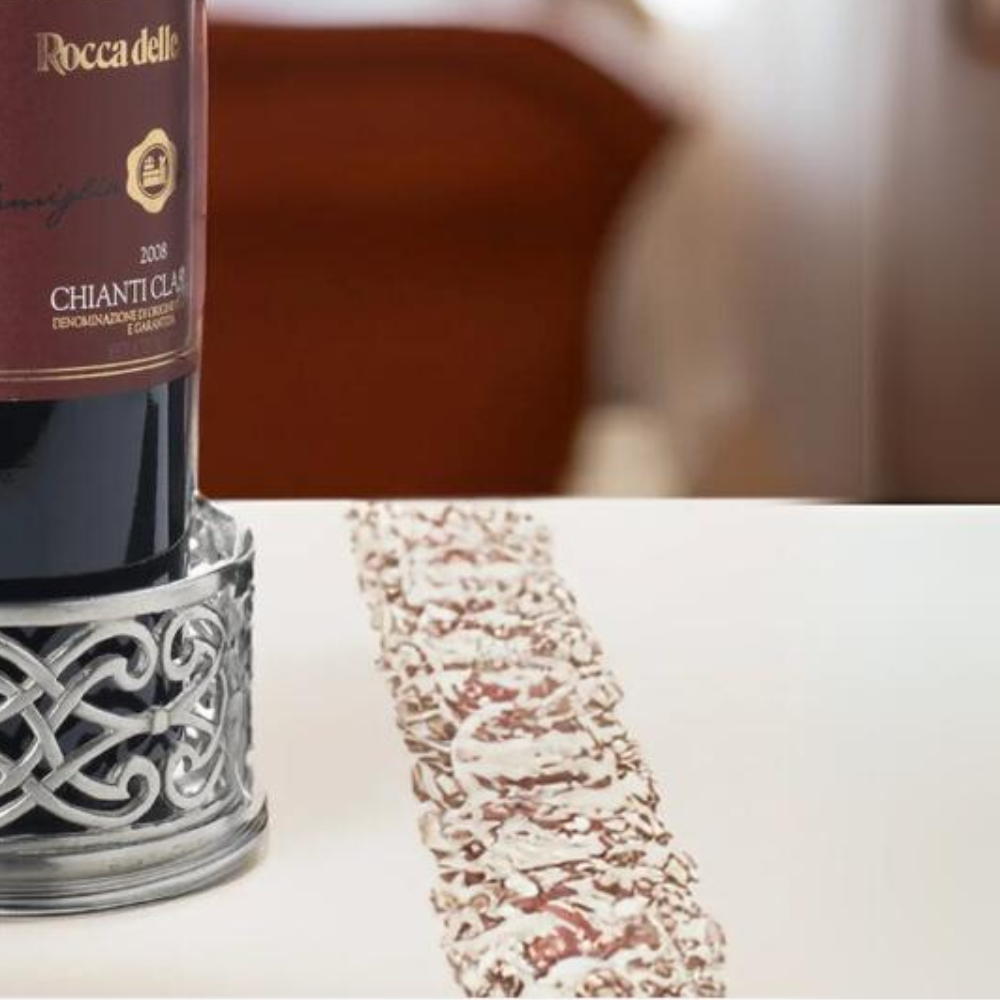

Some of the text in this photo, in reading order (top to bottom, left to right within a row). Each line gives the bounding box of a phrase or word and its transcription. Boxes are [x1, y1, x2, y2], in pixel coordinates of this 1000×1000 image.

[36, 23, 179, 76] Rocca delle
[140, 241, 169, 265] 2008
[50, 278, 148, 312] CHIANTI
